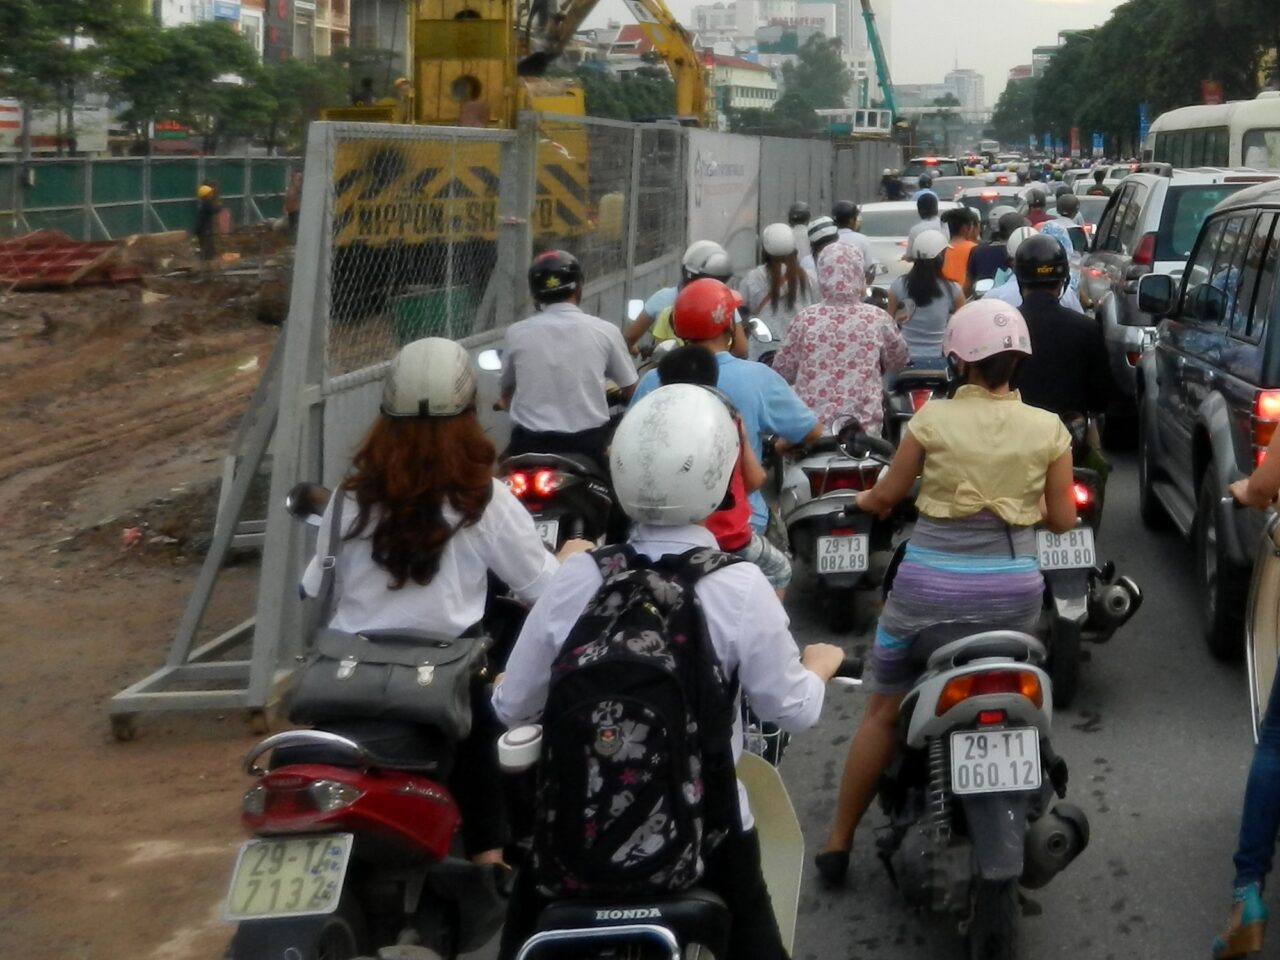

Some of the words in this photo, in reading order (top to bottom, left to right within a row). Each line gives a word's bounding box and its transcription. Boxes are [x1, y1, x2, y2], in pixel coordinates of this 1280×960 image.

[821, 553, 865, 570] 082.89
[1042, 548, 1092, 566] 308.80
[964, 731, 1025, 760] 29-T1
[957, 759, 1035, 790] 060.12
[595, 907, 662, 920] HONDA
